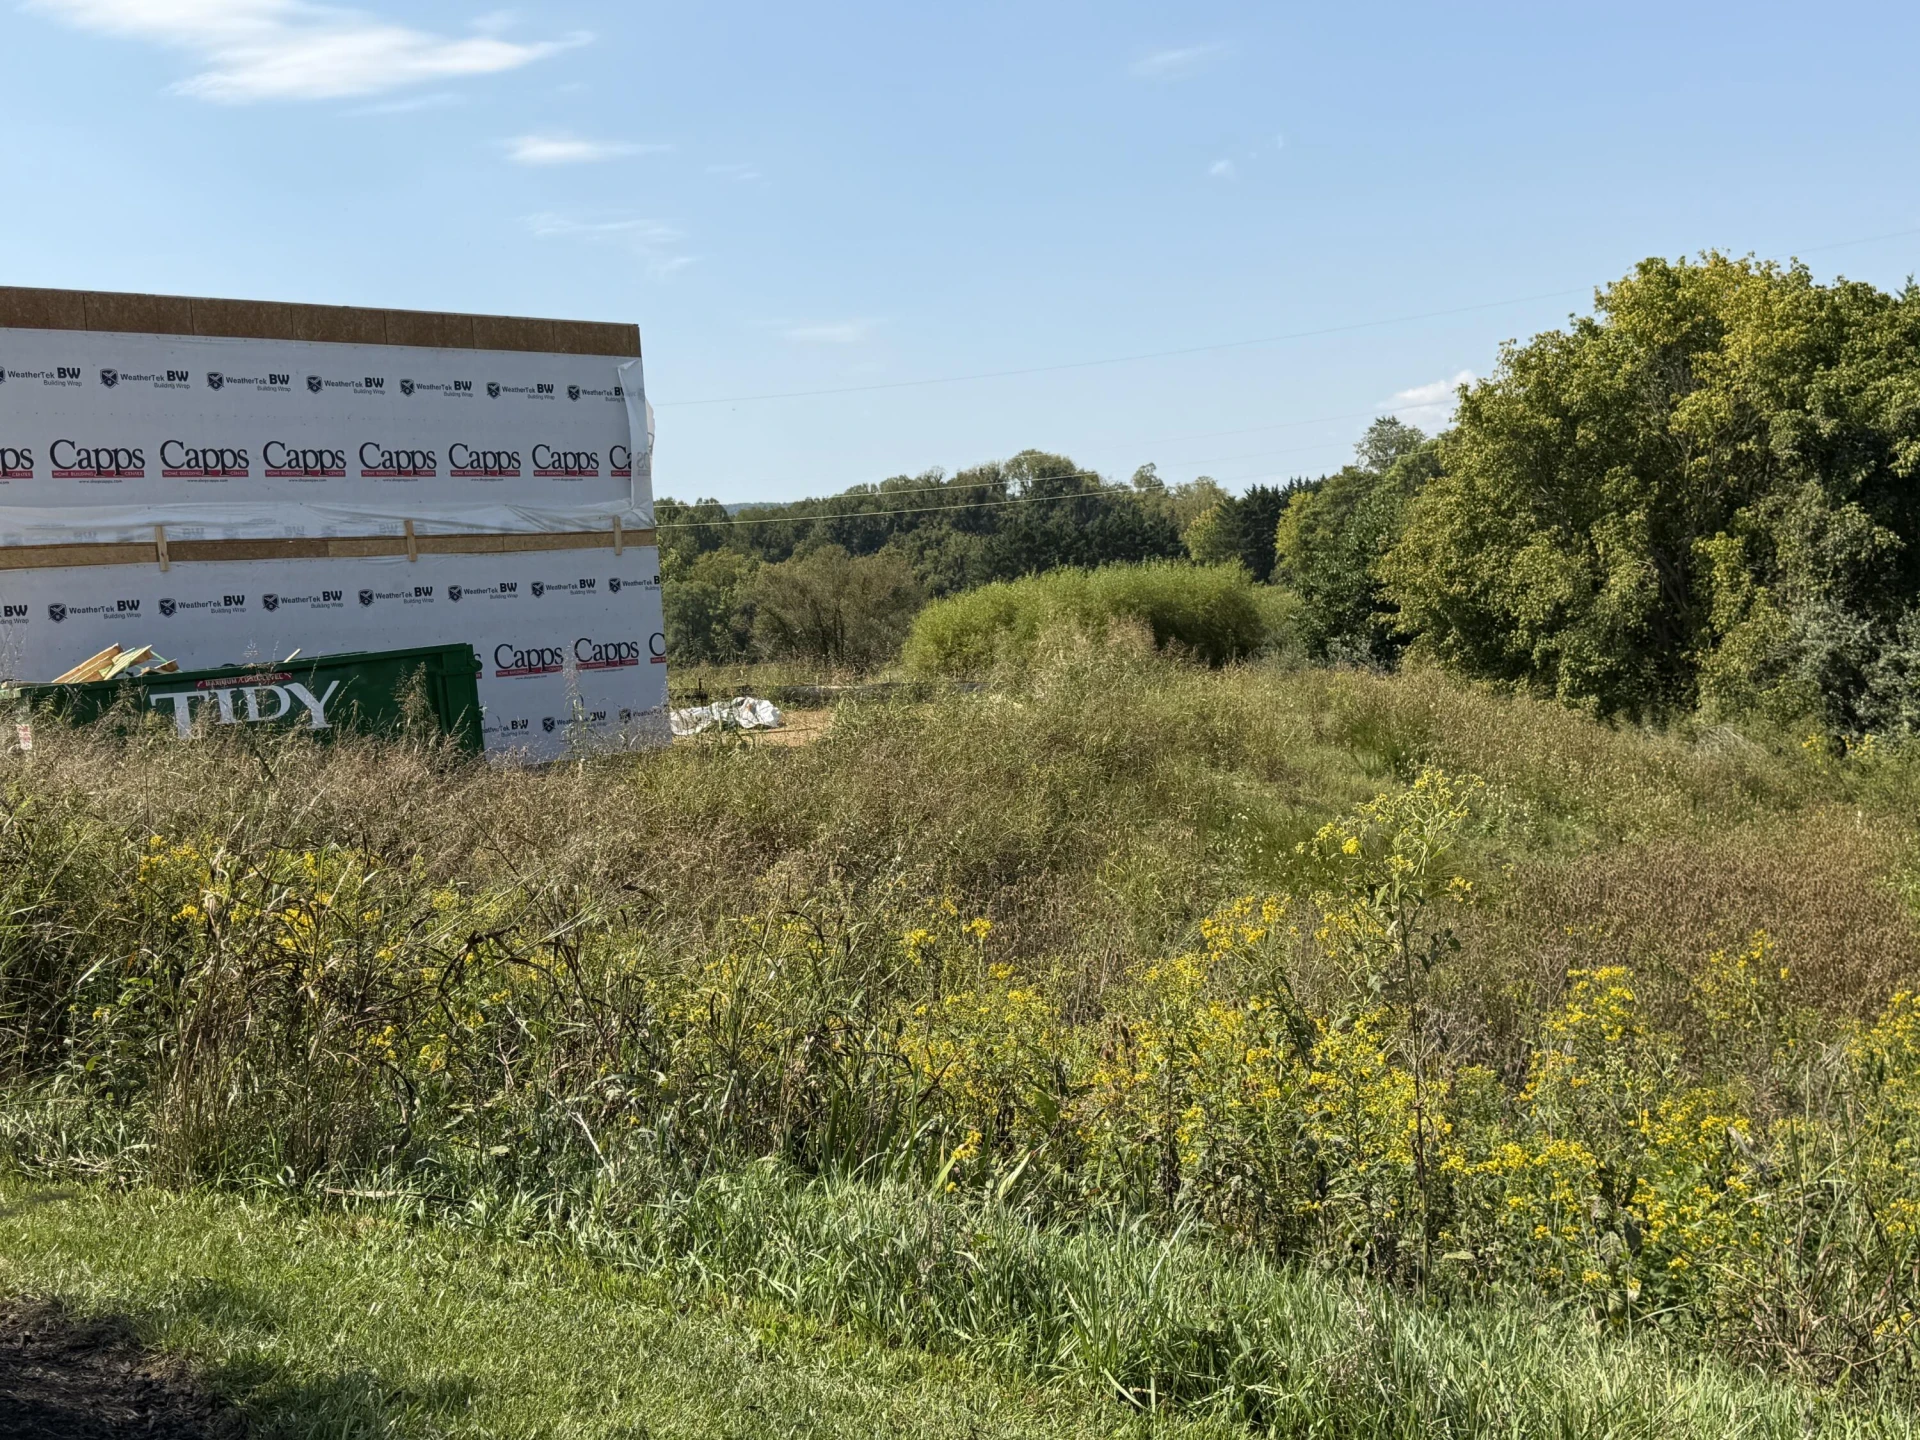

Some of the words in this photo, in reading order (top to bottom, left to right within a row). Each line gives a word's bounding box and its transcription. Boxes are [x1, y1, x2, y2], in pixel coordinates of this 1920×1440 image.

[7, 371, 54, 379] WeatherTek
[57, 367, 80, 379] BW
[120, 374, 164, 382] WeatherTek
[167, 370, 188, 381] BW
[226, 377, 267, 385] WeatherTek
[269, 374, 289, 385] BW
[324, 380, 363, 388] WeatherTek
[364, 377, 384, 388] BW
[416, 383, 452, 391] WeatherTek
[454, 381, 472, 391] BW
[537, 384, 554, 394] BW
[49, 439, 146, 476] Capps
[160, 440, 250, 476] Capps
[263, 441, 347, 476] Capps
[359, 442, 437, 476] Capps
[448, 443, 522, 476] Capps
[532, 444, 599, 476] Capps
[500, 582, 517, 593] BW
[579, 578, 595, 589] BW
[281, 596, 320, 604] WeatherTek
[322, 590, 342, 602] BW
[375, 592, 412, 600] WeatherTek
[414, 586, 433, 597] BW
[69, 606, 114, 614] WeatherTek
[117, 600, 140, 612] BW
[178, 601, 221, 609] WeatherTek
[223, 595, 245, 607] BW
[4, 605, 27, 617] BW
[494, 643, 564, 673] Capps
[574, 637, 640, 667] Capps
[205, 678, 237, 686] MAXIMUM
[150, 680, 339, 738] TIDY
[511, 719, 528, 730] BW
